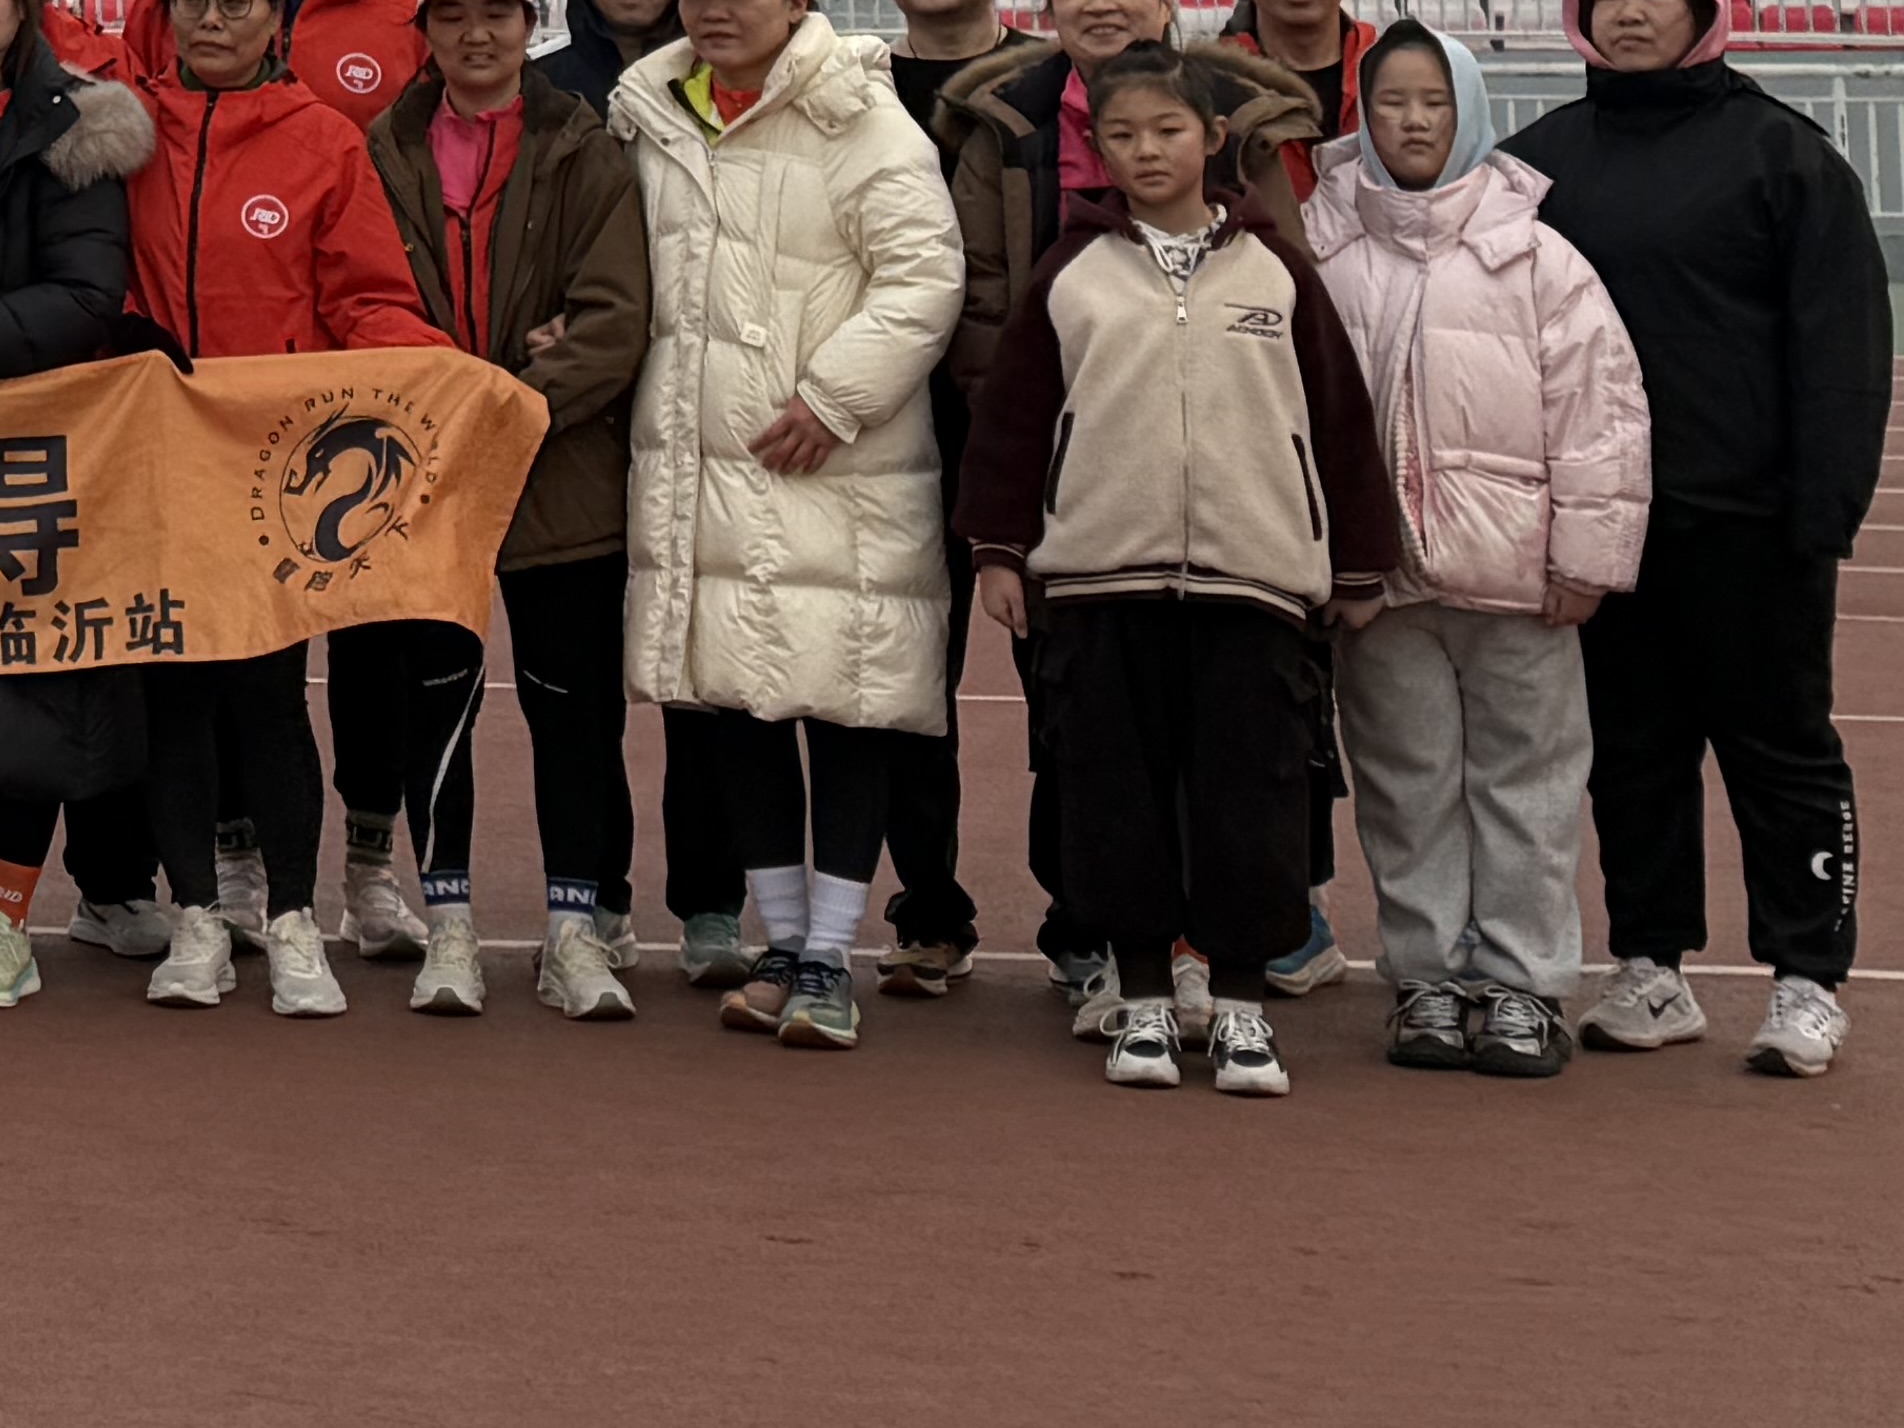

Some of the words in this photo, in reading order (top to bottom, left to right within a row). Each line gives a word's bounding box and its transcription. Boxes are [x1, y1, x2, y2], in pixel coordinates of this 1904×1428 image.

[250, 415, 295, 522] DRAGON
[304, 387, 355, 413] RUN
[372, 388, 415, 415] THE
